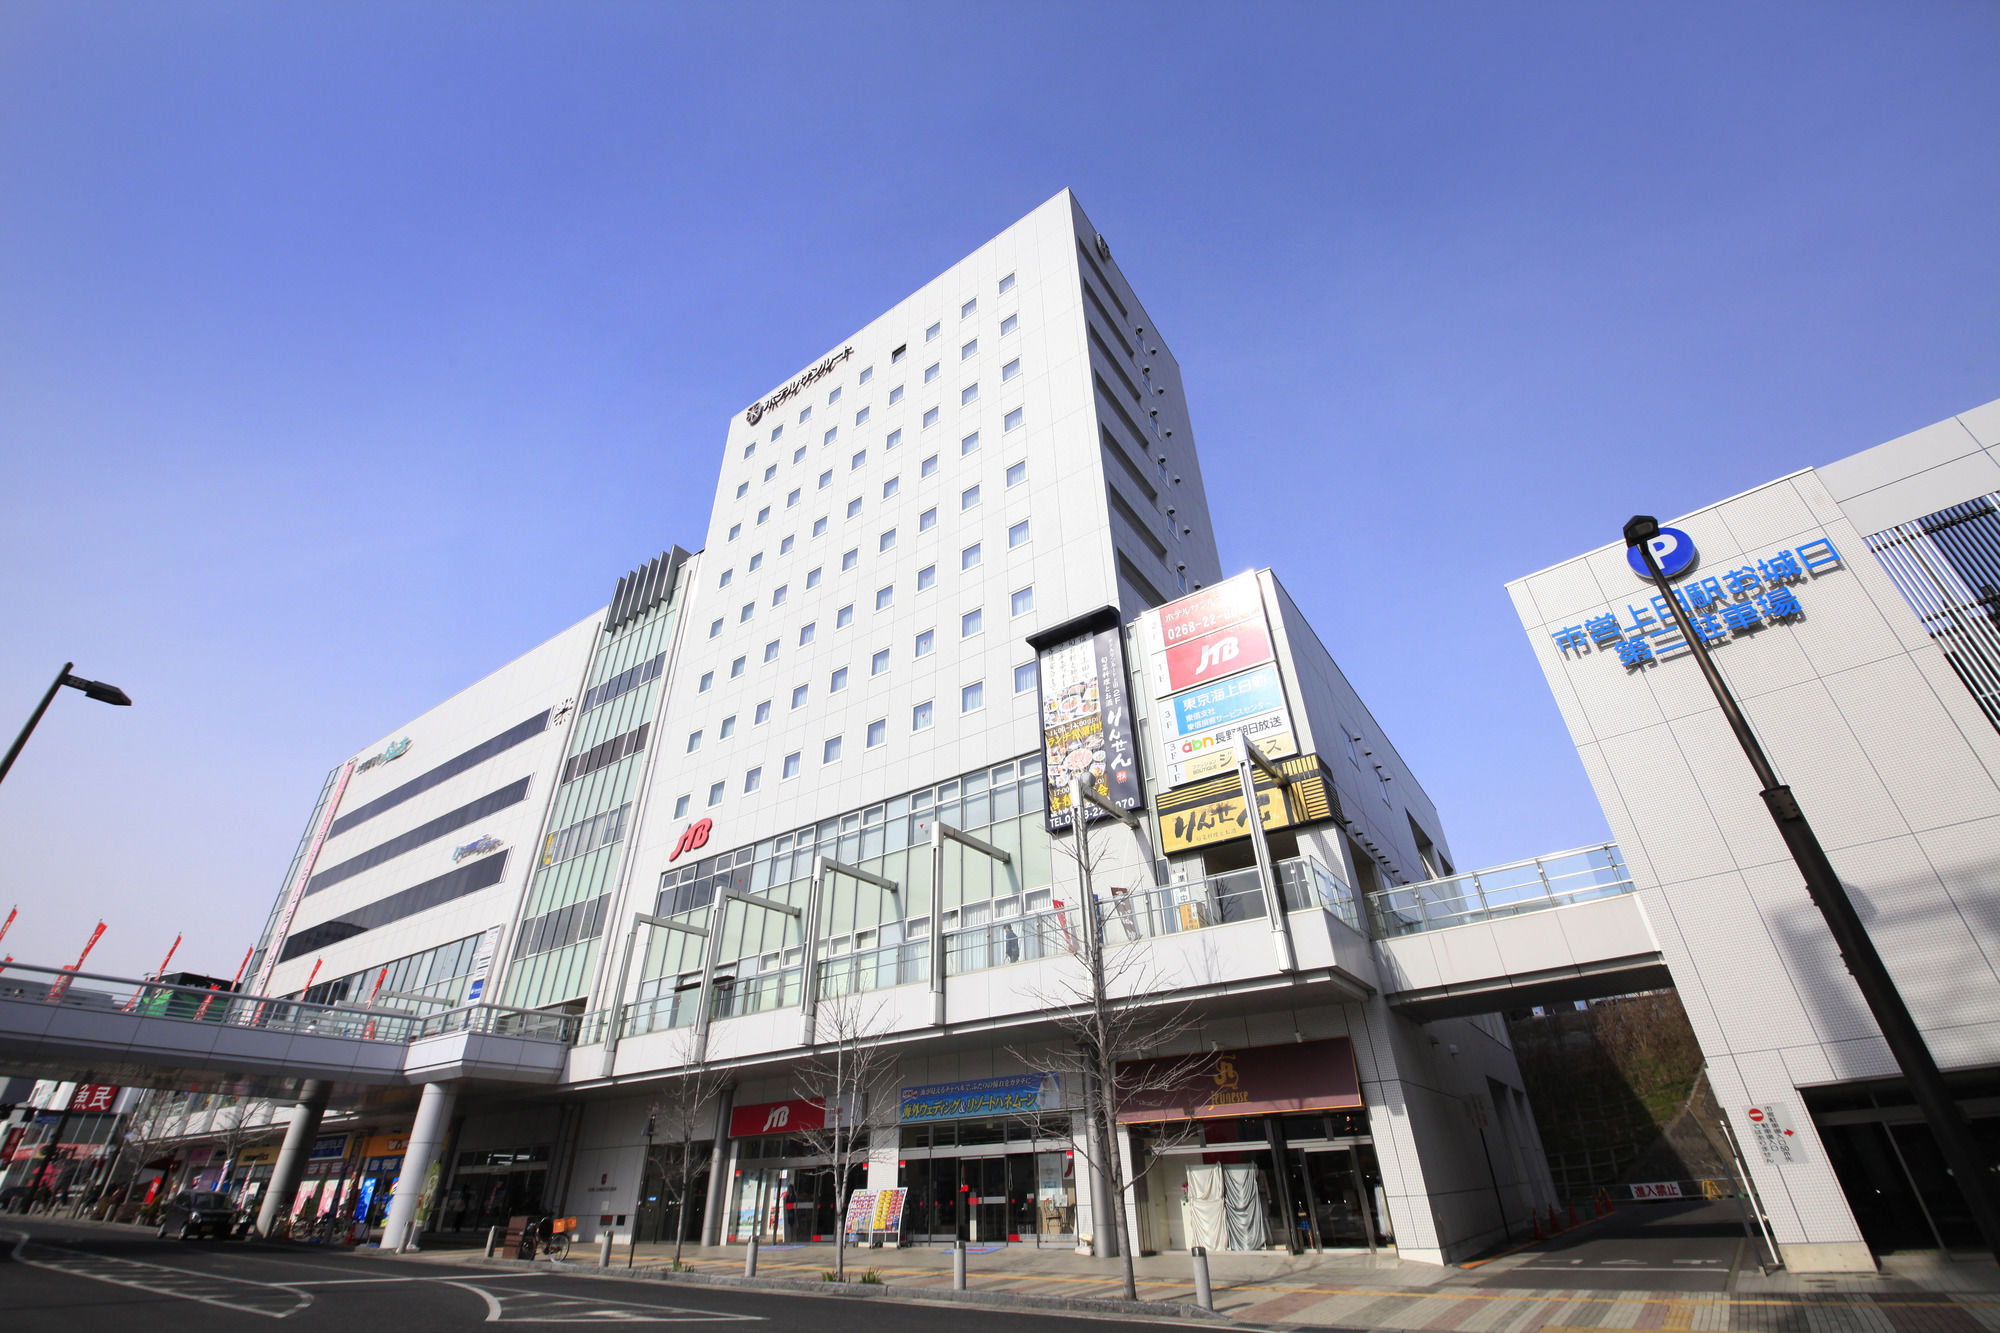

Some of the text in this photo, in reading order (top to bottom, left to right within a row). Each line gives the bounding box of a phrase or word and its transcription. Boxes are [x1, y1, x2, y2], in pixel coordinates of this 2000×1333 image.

[1647, 534, 1678, 570] P
[1551, 537, 1840, 653] 市営上田駅お城口
[1614, 585, 1802, 667] 第二駐車場
[1195, 636, 1240, 675] JTB
[1106, 707, 1133, 770] りんせん
[669, 818, 712, 862] JTB
[73, 1083, 112, 1110] 魚民
[763, 1106, 790, 1132] JTB
[1634, 1184, 1679, 1198] 進入禁止
